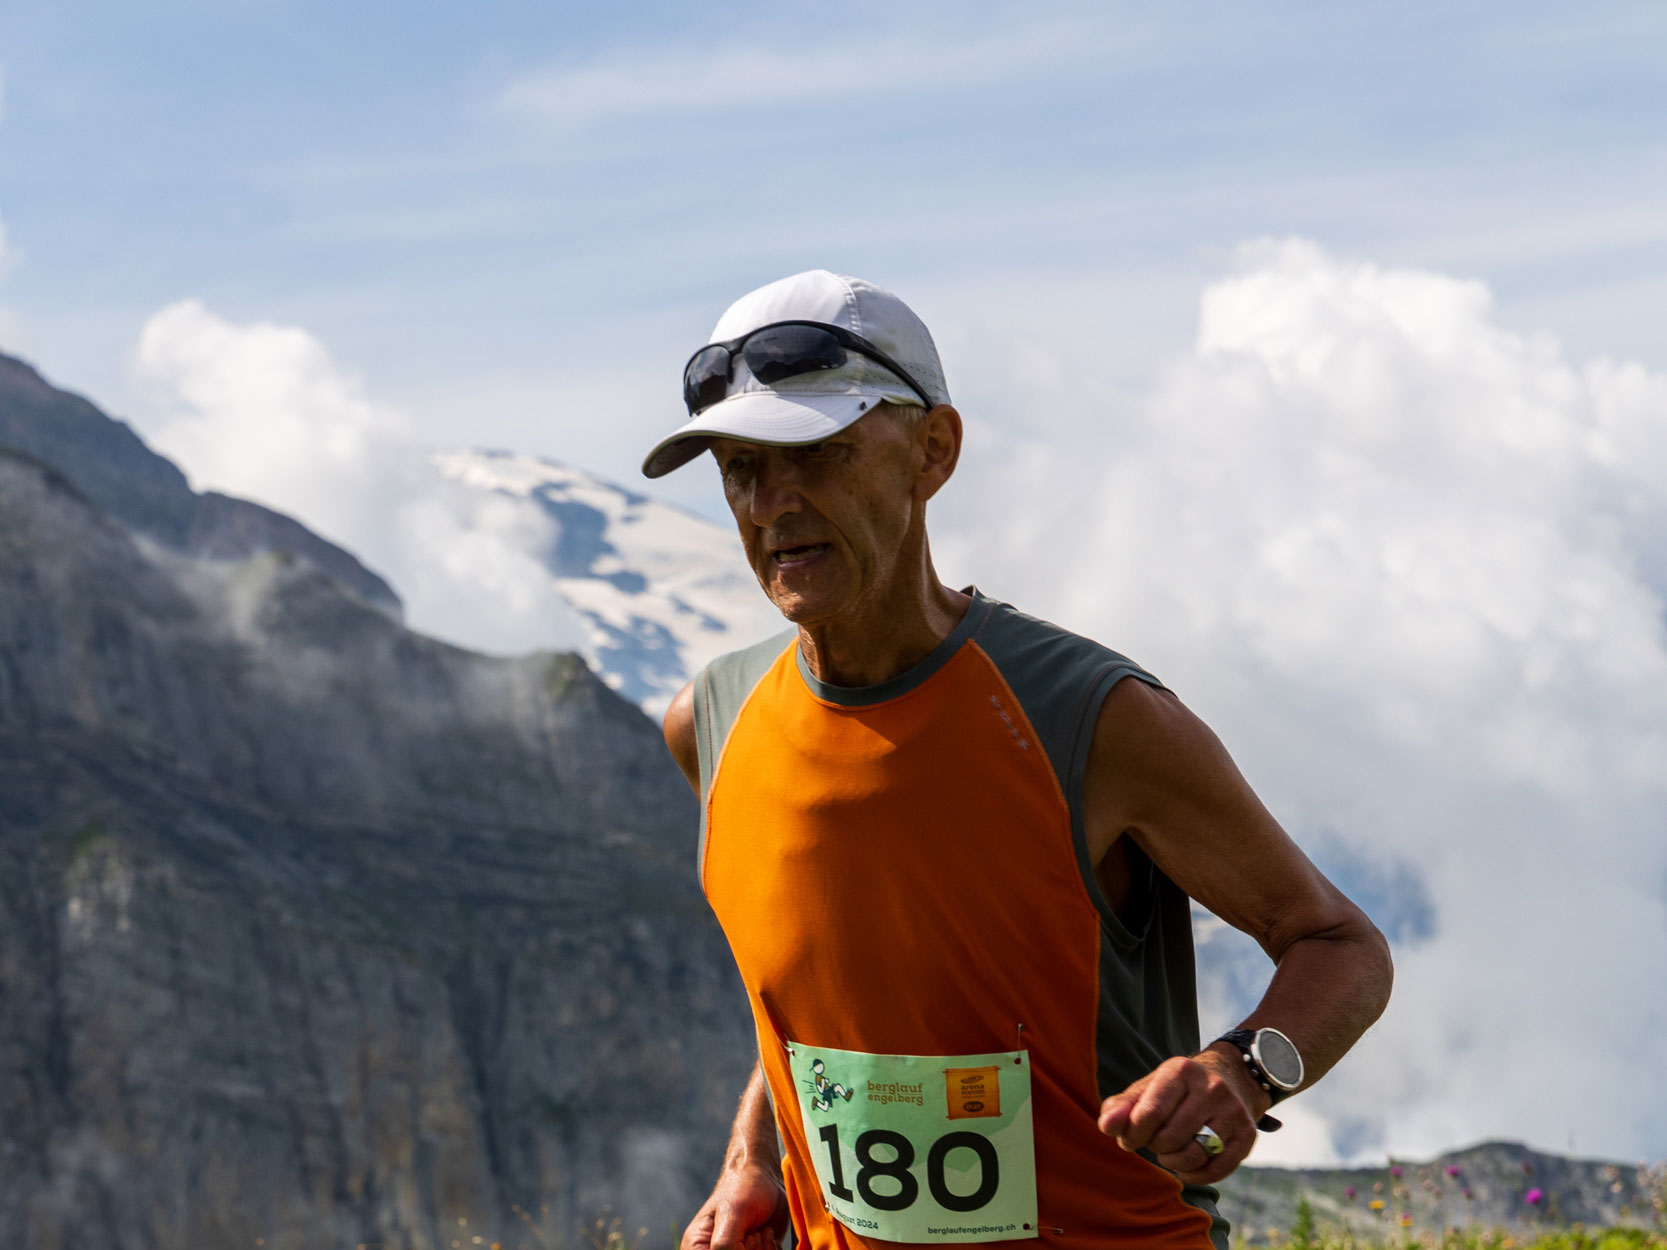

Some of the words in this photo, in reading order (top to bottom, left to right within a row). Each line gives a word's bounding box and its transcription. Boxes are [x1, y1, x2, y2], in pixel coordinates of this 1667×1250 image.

[867, 1080, 923, 1095] berglauf
[867, 1093, 923, 1106] engelberg
[819, 1123, 999, 1212] 180
[857, 1218, 878, 1230] 2024
[927, 1223, 1016, 1235] berglaufengelberg.ch
